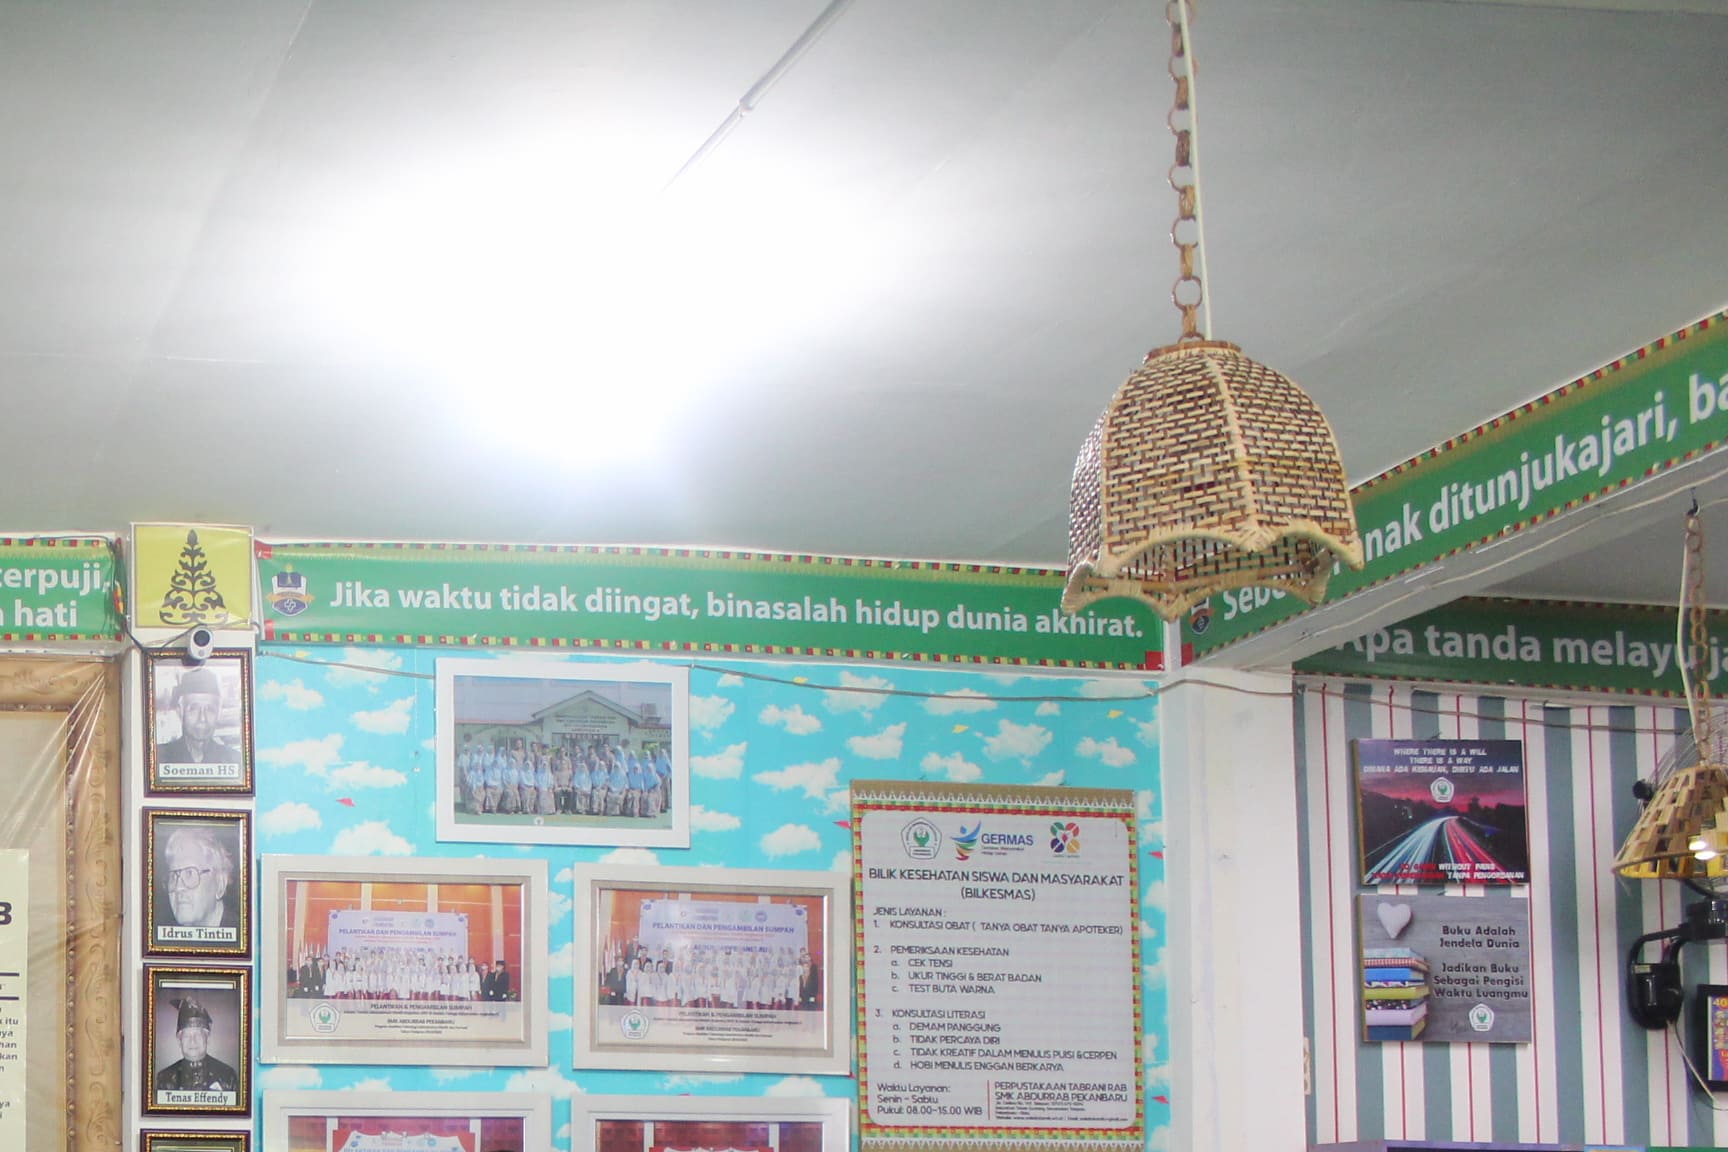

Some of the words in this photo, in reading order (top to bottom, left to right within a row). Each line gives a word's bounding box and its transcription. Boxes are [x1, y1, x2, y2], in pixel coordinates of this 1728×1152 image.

[1429, 391, 1678, 534] ditunjukajari,
[14, 600, 77, 628] hati
[330, 582, 390, 609] Jika
[398, 584, 493, 611] waktu
[500, 586, 576, 613] tidak
[585, 588, 699, 620] diingat,
[707, 591, 847, 625] binasalah
[856, 598, 939, 633] hidup
[947, 604, 1028, 632] dunia
[1035, 608, 1143, 637] akhirat.
[1425, 625, 1543, 662] tanda
[163, 764, 213, 775] Soeman
[218, 765, 235, 775] HS
[981, 833, 1034, 846] GERMAS
[868, 868, 897, 877] BILIK
[899, 869, 970, 879] KESEHATAN
[971, 871, 1010, 881] SISWA
[1011, 872, 1039, 882] DAN
[1040, 874, 1125, 884] MASYARAKAT
[961, 888, 1035, 902] (BILKESMAS)
[162, 928, 193, 939] Idrus
[196, 928, 233, 939] Tintin
[1442, 926, 1471, 936] Buku
[1475, 926, 1516, 936] Adalah
[1440, 938, 1482, 948] Jendela
[1487, 939, 1520, 948] Dunia
[1442, 963, 1486, 973] Jadikan
[1491, 964, 1519, 973] Buku
[1433, 976, 1479, 986] Sebagai
[1483, 976, 1524, 987] Pengisi
[1435, 989, 1472, 998] Waktu
[1476, 989, 1528, 1000] Luangmu
[892, 1009, 945, 1018] KONSULTASI
[947, 1010, 985, 1019] LITERASI
[5, 1017, 19, 1025] itu
[974, 1061, 1014, 1071] ENGGAN
[1016, 1063, 1064, 1072] BERKARYA
[877, 1083, 906, 1093] Waktu
[908, 1083, 950, 1095] Layanan:
[994, 1081, 1066, 1091] PERPUSTAKAAN
[1068, 1082, 1106, 1092] TABRANI
[1108, 1083, 1127, 1092] RAB
[165, 1092, 192, 1102] Tenas
[194, 1093, 228, 1105] Effendy
[877, 1094, 903, 1104] Senin
[912, 1095, 938, 1104] Sabtu
[995, 1092, 1014, 1101] SMK
[1017, 1092, 1069, 1101] ABDURRAB
[1071, 1093, 1127, 1102] PEKANBARU
[877, 1105, 904, 1115] Pukul:
[906, 1106, 962, 1115] 08.00-15.00
[964, 1106, 982, 1116] WIB
